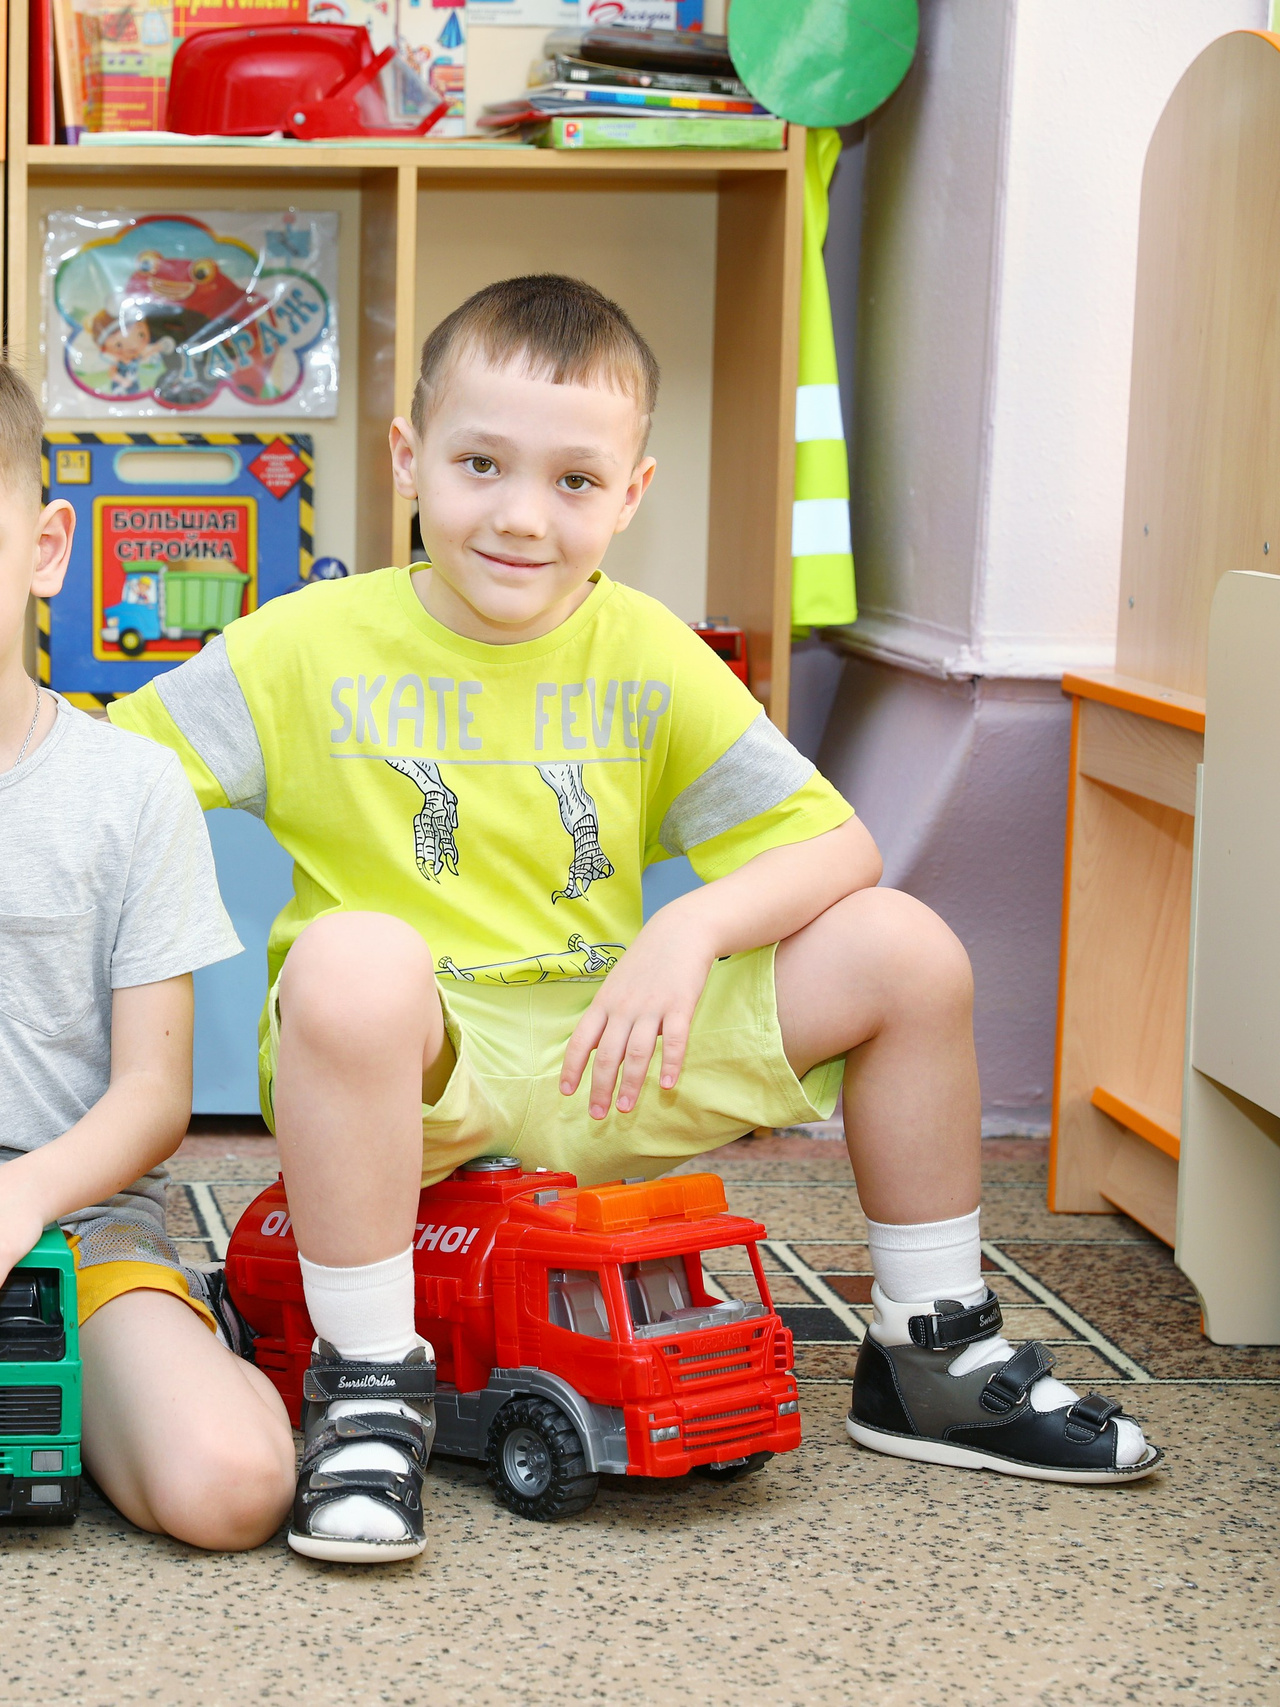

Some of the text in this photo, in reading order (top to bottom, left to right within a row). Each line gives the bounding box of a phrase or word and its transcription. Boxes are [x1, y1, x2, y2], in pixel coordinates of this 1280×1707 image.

[111, 510, 238, 531] БОЛЬШАЯ
[115, 532, 235, 560] СТРОЙКА
[330, 673, 671, 751] SKATE FEVER
[338, 1374, 396, 1389] SursilOrtho
